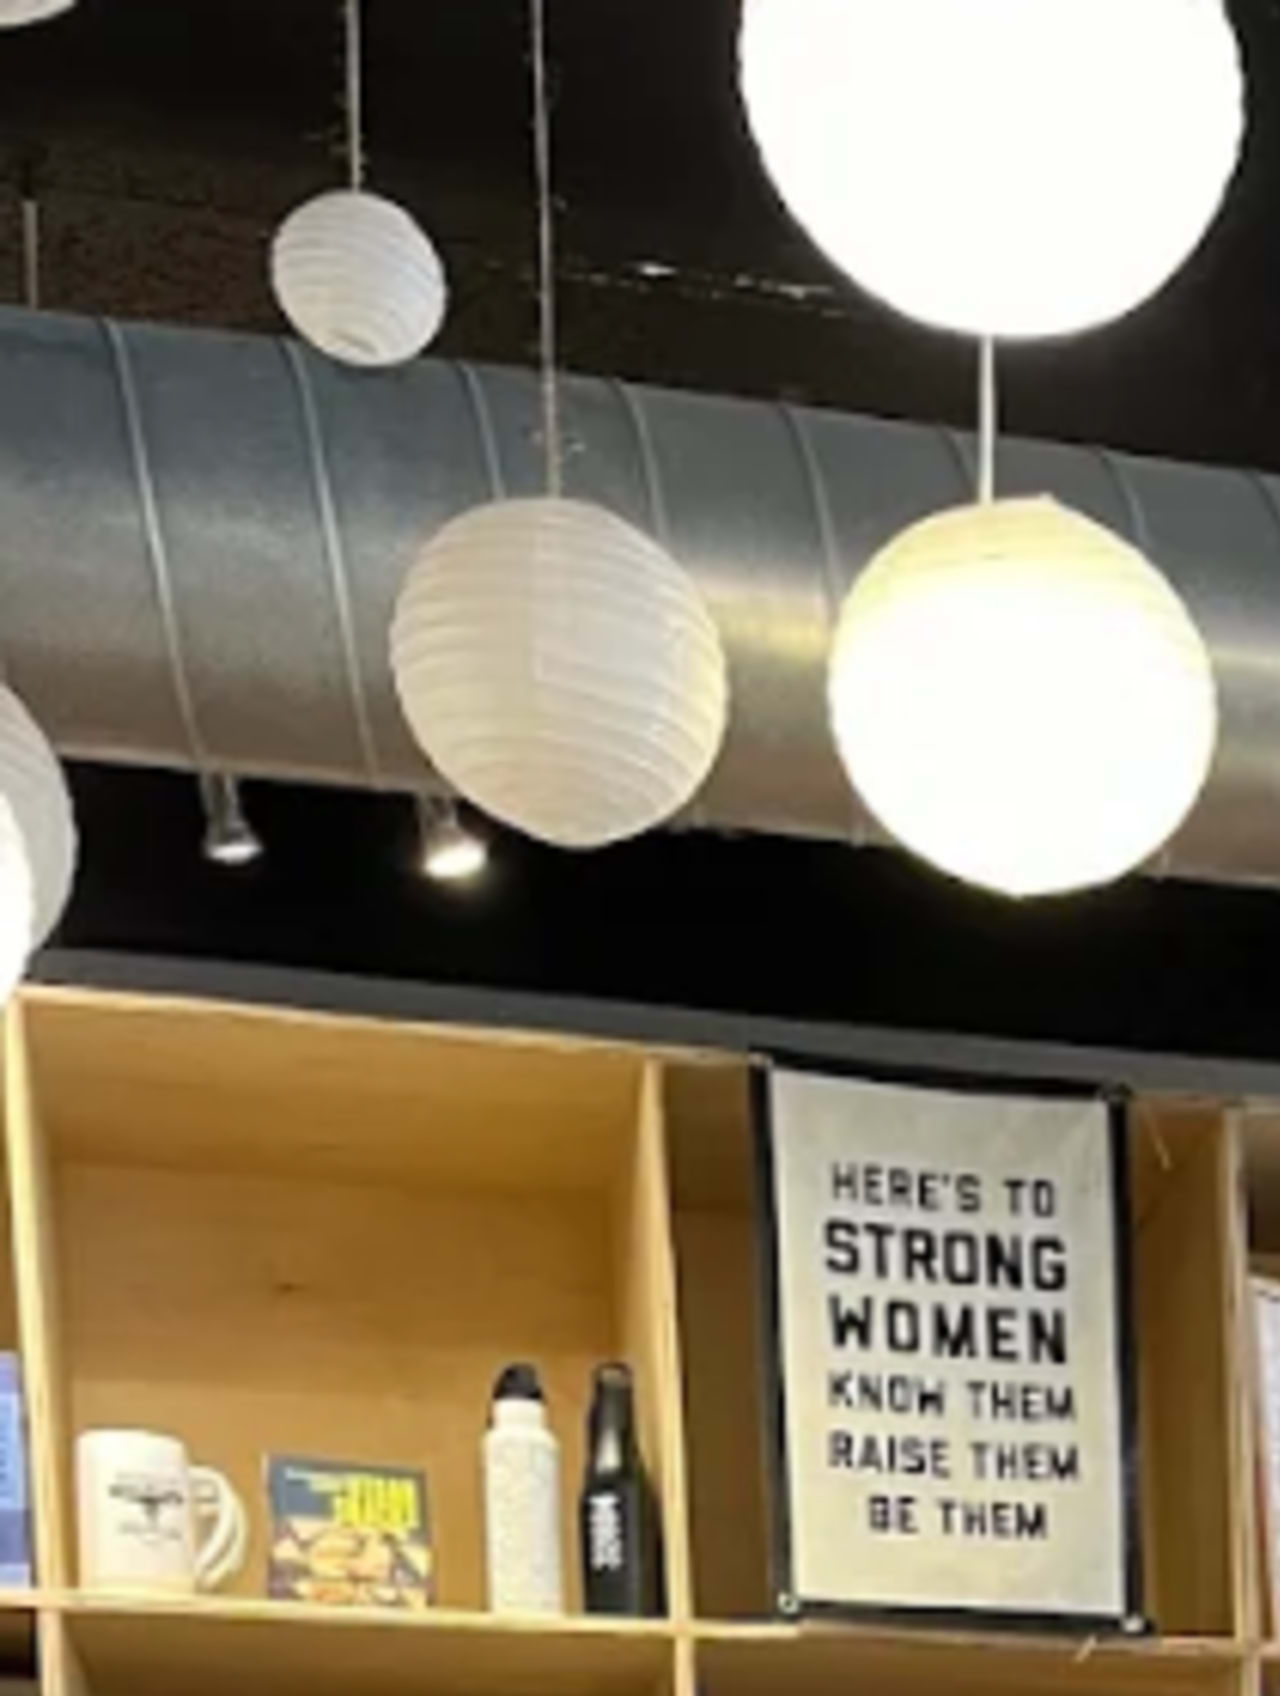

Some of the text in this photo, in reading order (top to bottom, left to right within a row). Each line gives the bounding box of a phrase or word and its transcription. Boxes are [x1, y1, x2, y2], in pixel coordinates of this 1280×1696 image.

[831, 1162, 1058, 1217] HERE'S TO
[824, 1221, 1068, 1292] STRONG
[827, 1296, 1069, 1365] WOMEN
[827, 1371, 1076, 1423] KNOW THEM
[827, 1435, 1080, 1482] RAISE THEM
[867, 1494, 1048, 1540] BE THEM
